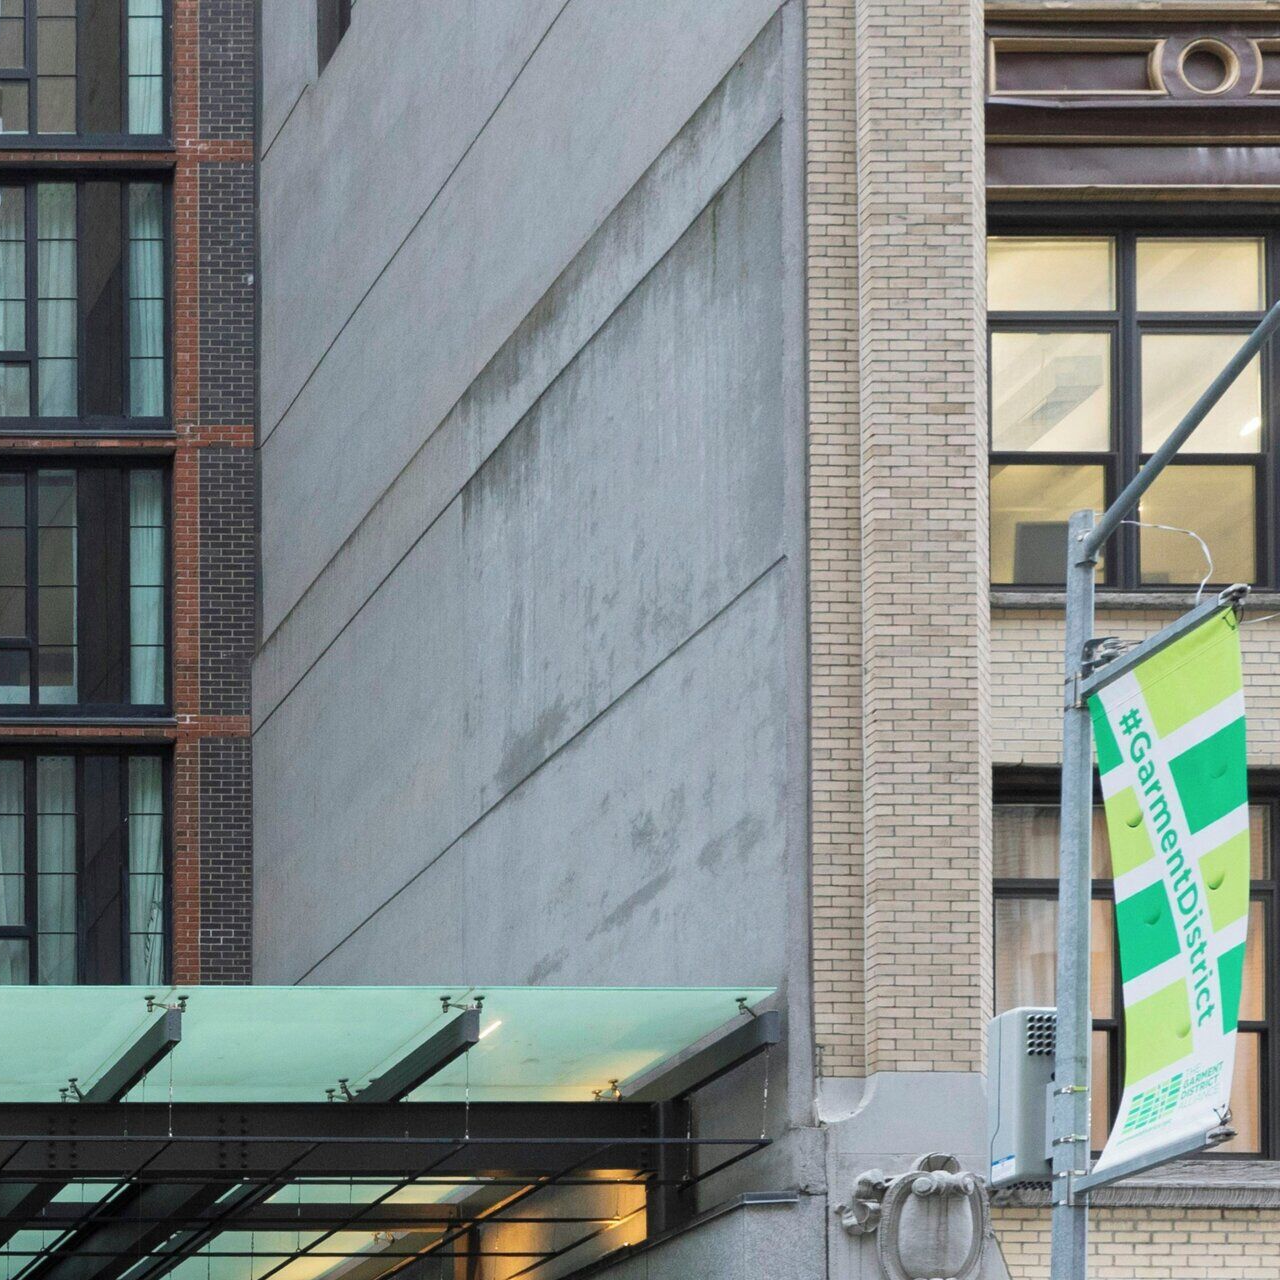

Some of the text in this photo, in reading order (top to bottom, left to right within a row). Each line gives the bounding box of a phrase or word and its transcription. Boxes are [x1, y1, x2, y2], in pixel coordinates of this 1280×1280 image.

[1119, 707, 1215, 1028] #GarmentDistrict
[1180, 1074, 1219, 1099] DISTRICT
[1182, 1060, 1224, 1088] GARMENT
